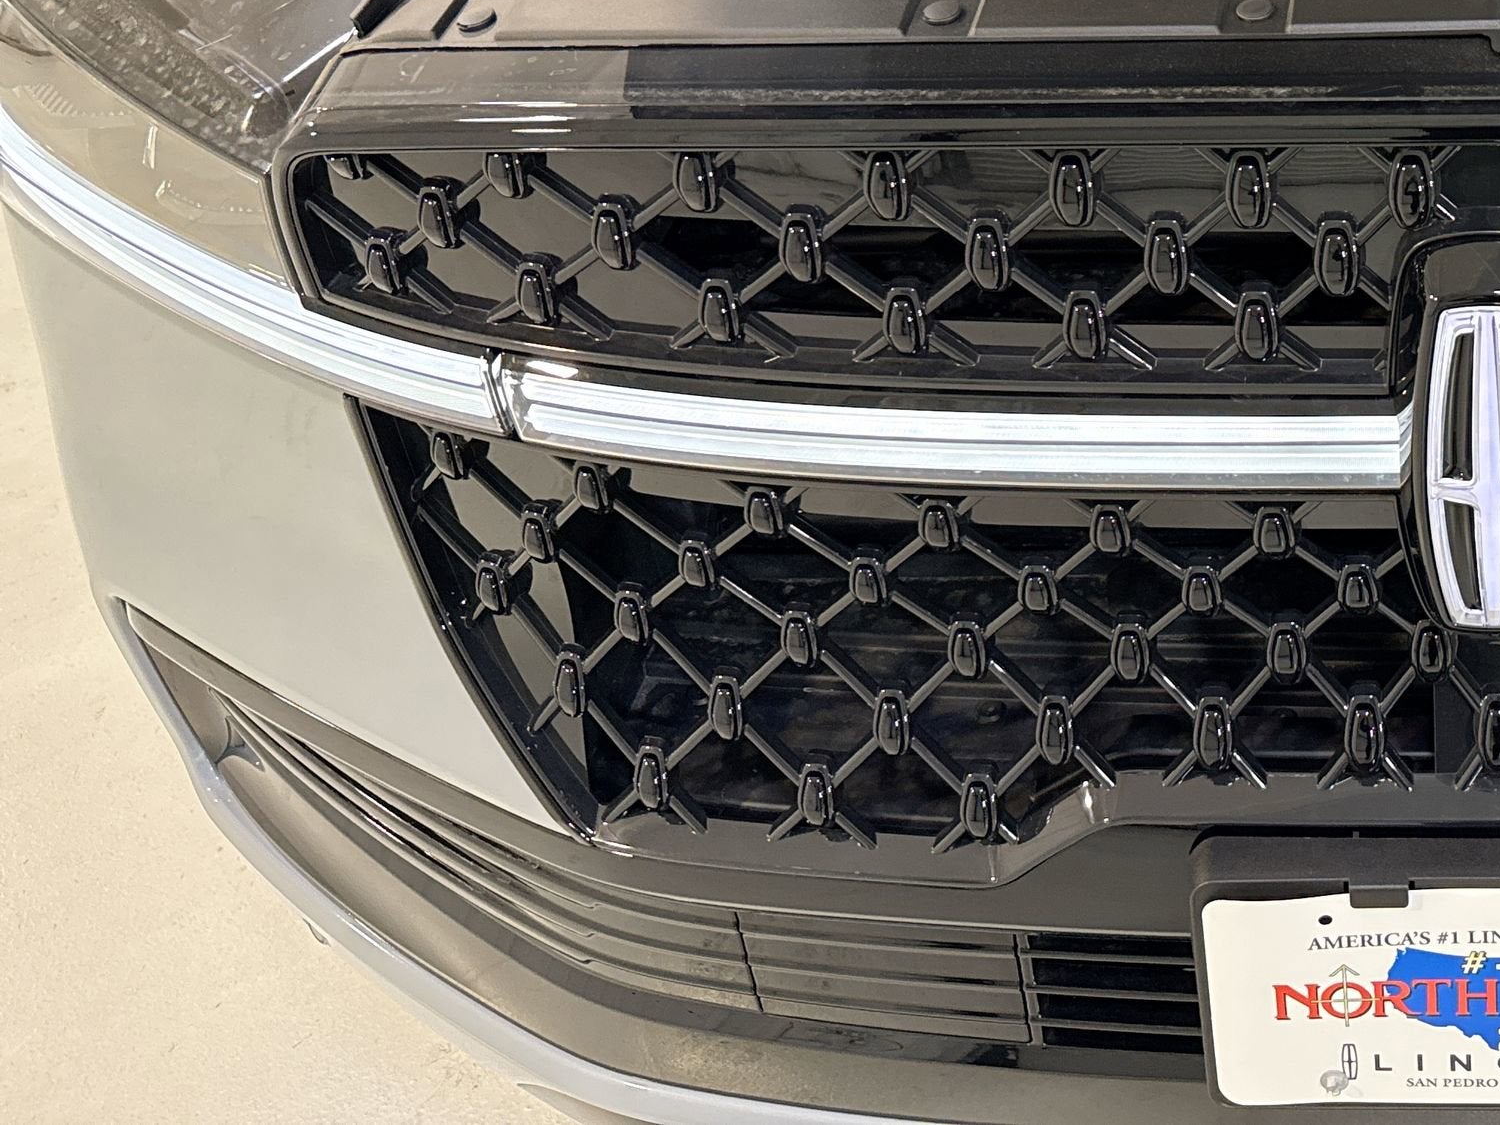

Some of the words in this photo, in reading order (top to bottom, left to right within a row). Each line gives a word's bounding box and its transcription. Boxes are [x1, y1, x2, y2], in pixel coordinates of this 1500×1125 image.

[1307, 930, 1431, 952] AMERICA'S
[1437, 931, 1459, 945] #1
[1272, 978, 1500, 1021] NORTH
[1405, 1077, 1438, 1088] SAN
[1443, 1078, 1499, 1088] PEDRO
